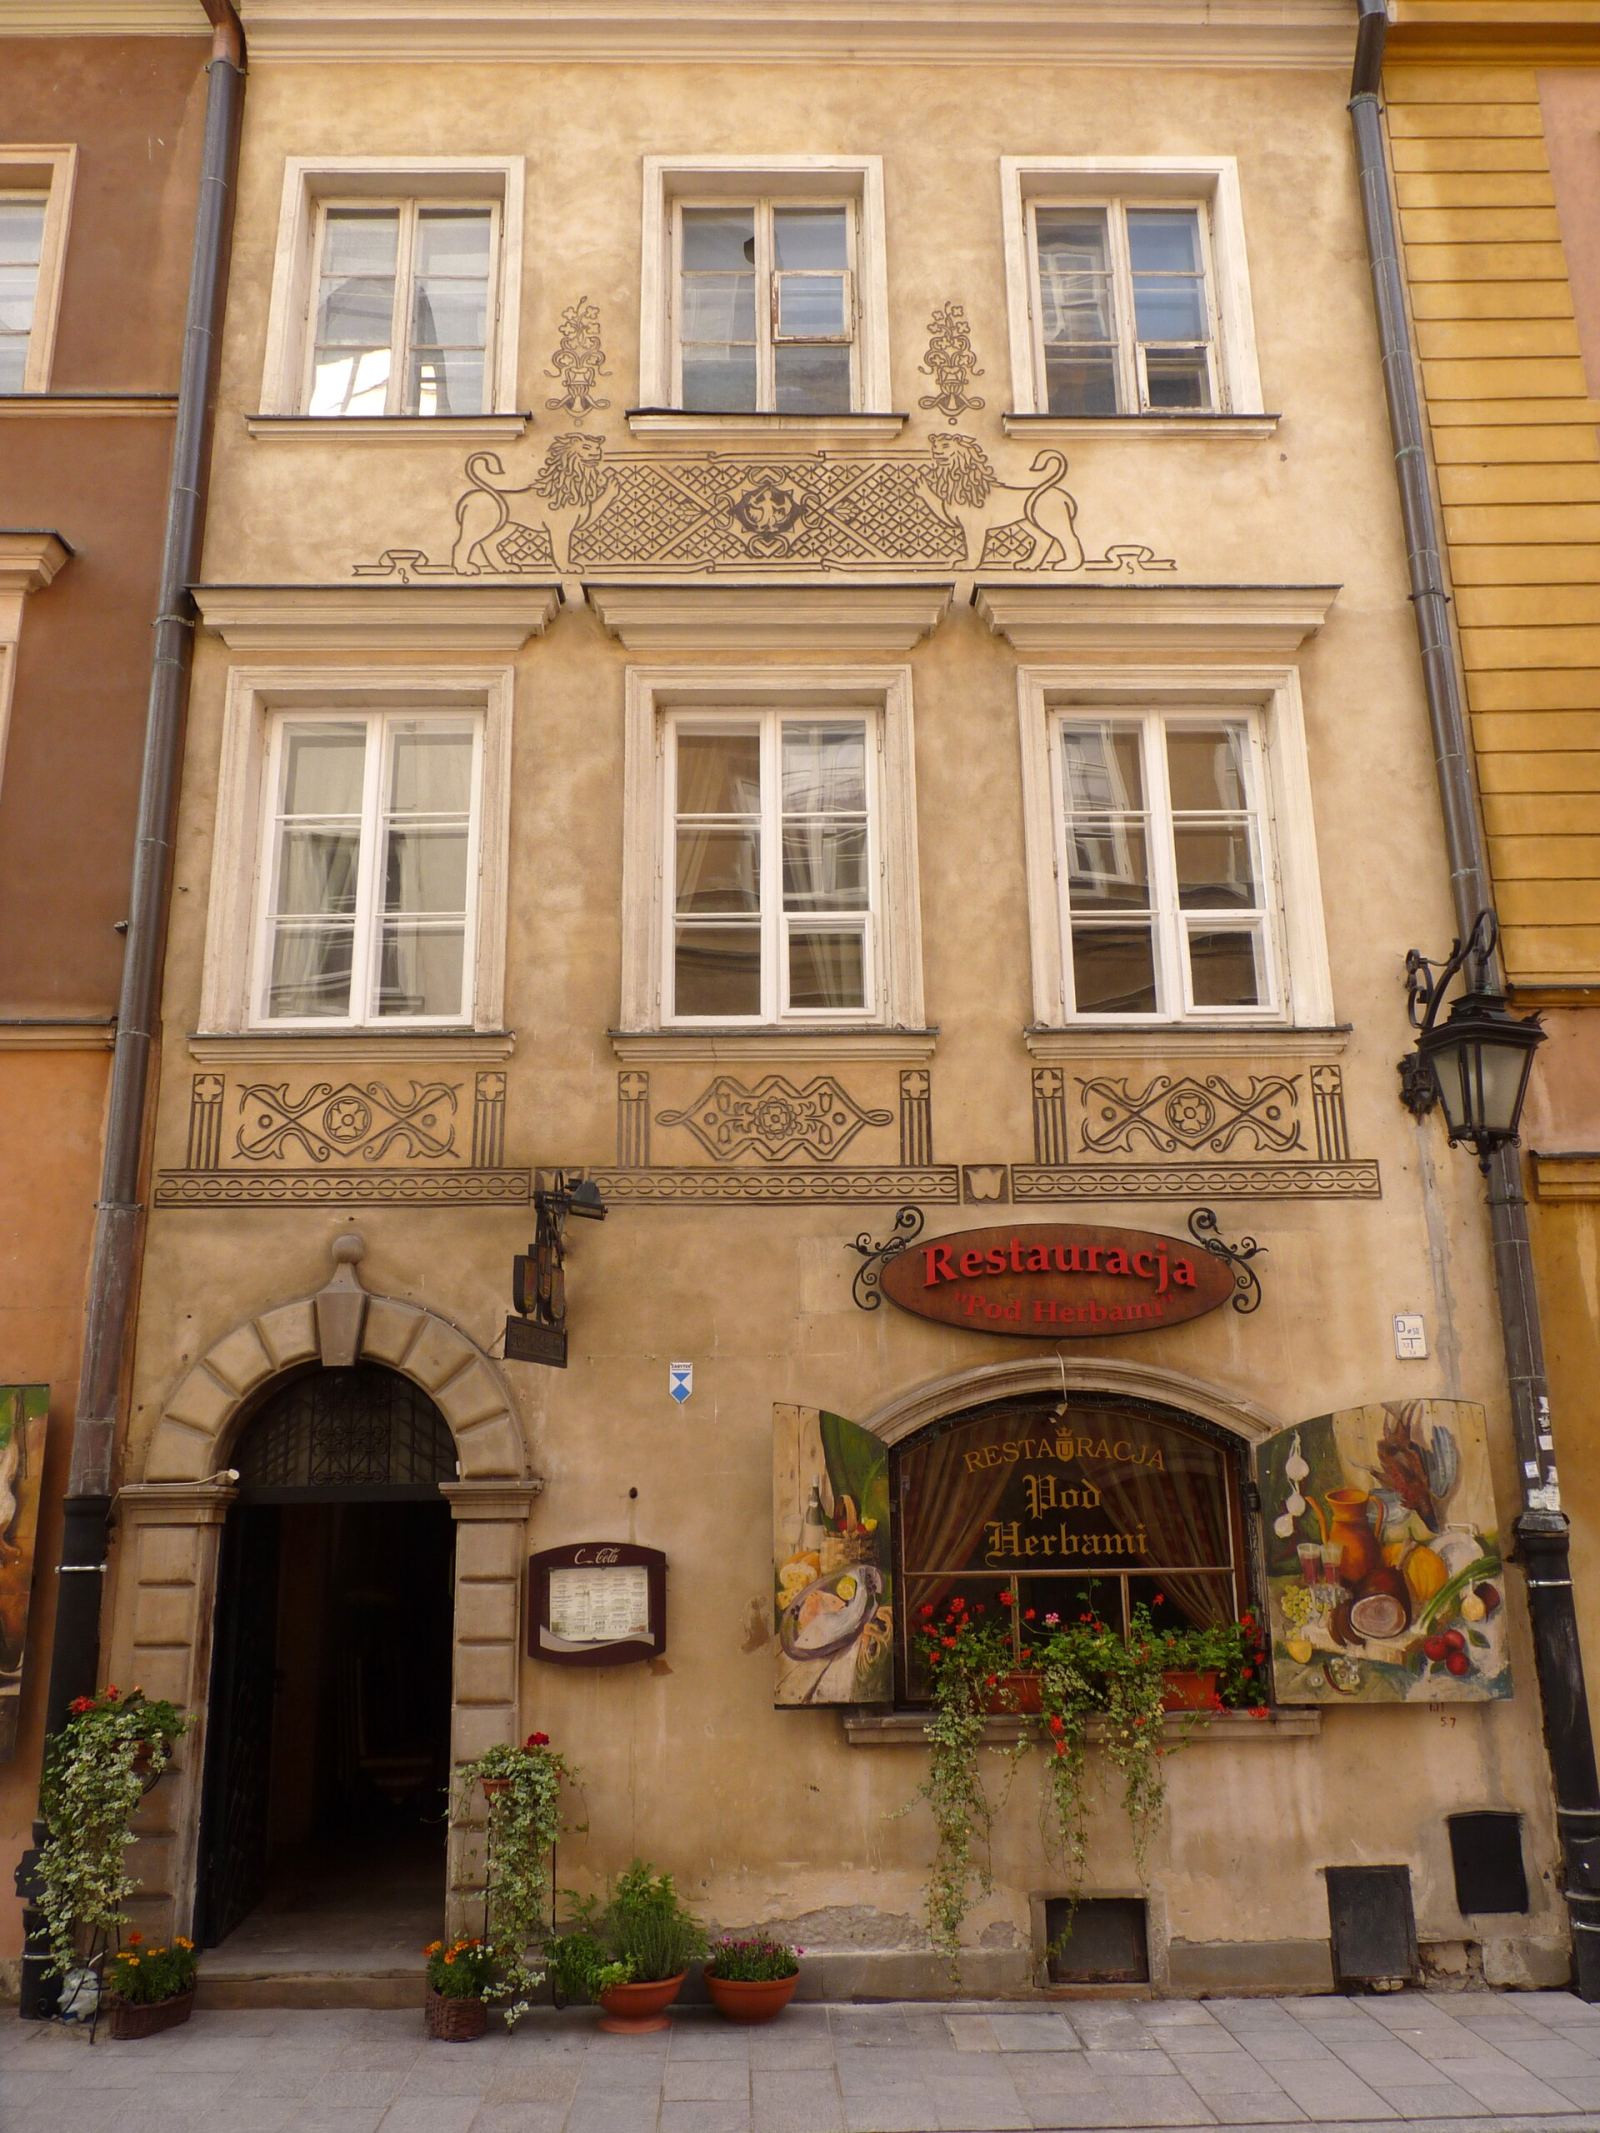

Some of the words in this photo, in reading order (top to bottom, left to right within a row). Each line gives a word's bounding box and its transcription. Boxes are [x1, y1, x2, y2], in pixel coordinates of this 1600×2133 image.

[923, 1237, 1198, 1293] Restauracja
[962, 1435, 1165, 1472] RESTAURACJA
[1022, 1474, 1102, 1520] Pod
[983, 1521, 1148, 1567] Herbami
